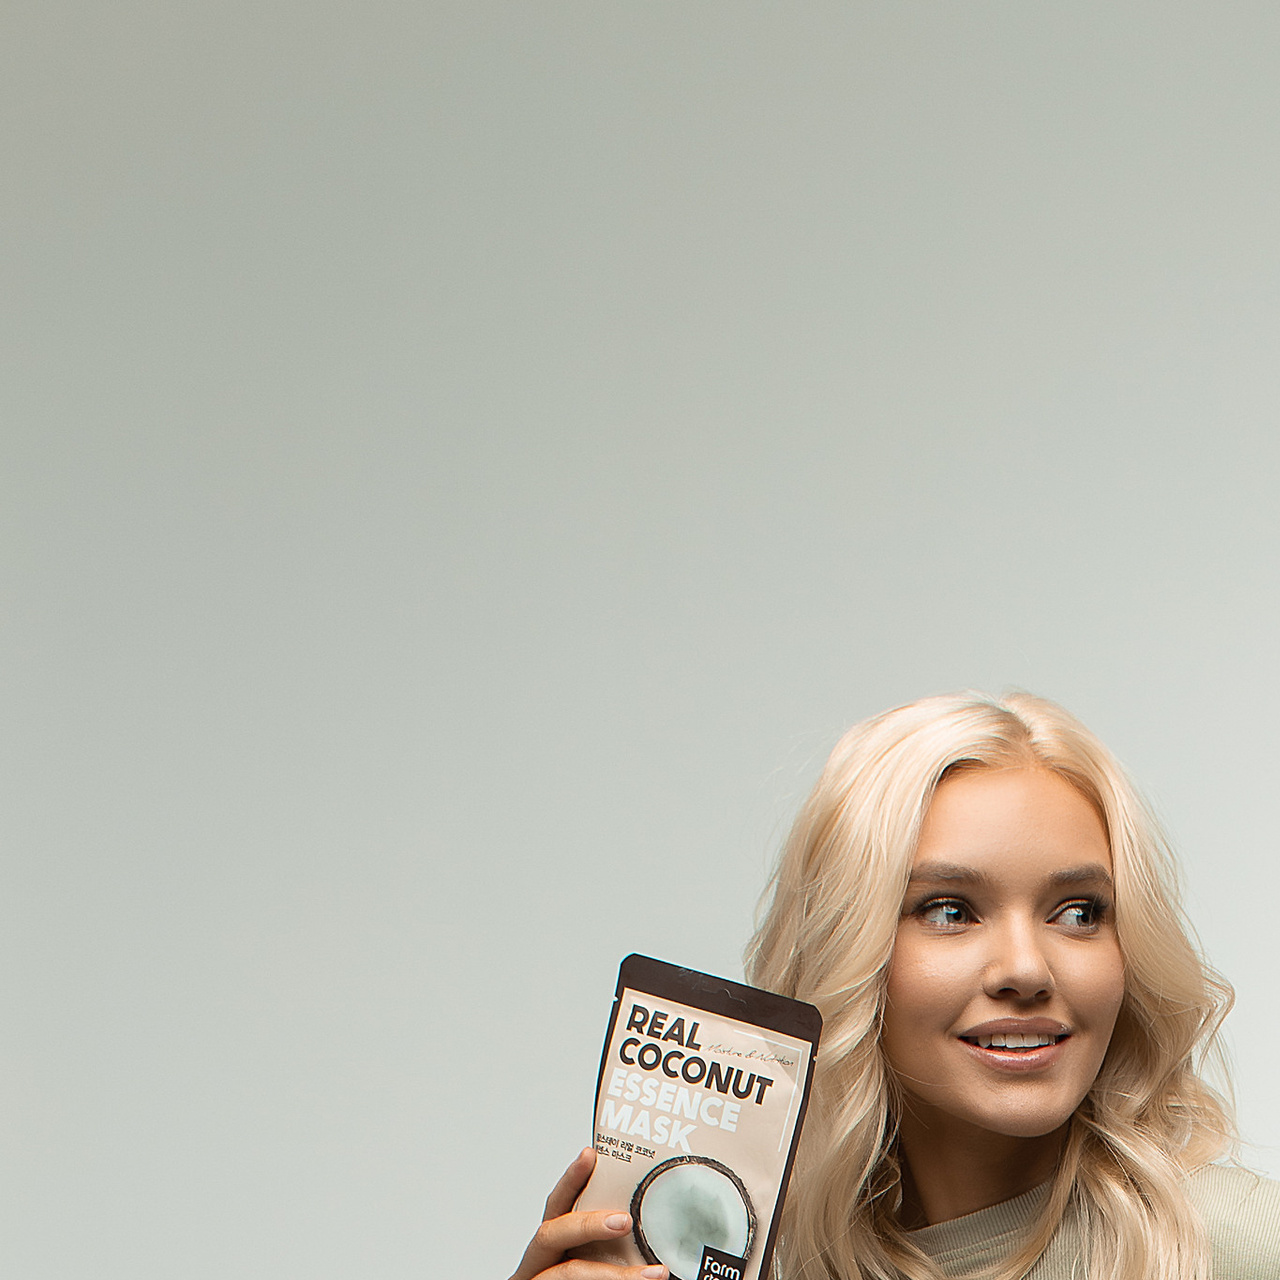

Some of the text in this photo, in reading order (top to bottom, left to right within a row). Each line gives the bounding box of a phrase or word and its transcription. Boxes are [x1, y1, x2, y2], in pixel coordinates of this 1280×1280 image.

[626, 1004, 702, 1051] REAL
[619, 1038, 774, 1106] COCONUT
[600, 1100, 697, 1154] MASK
[607, 1067, 741, 1133] ESSENCE
[611, 1150, 632, 1164] 마스크
